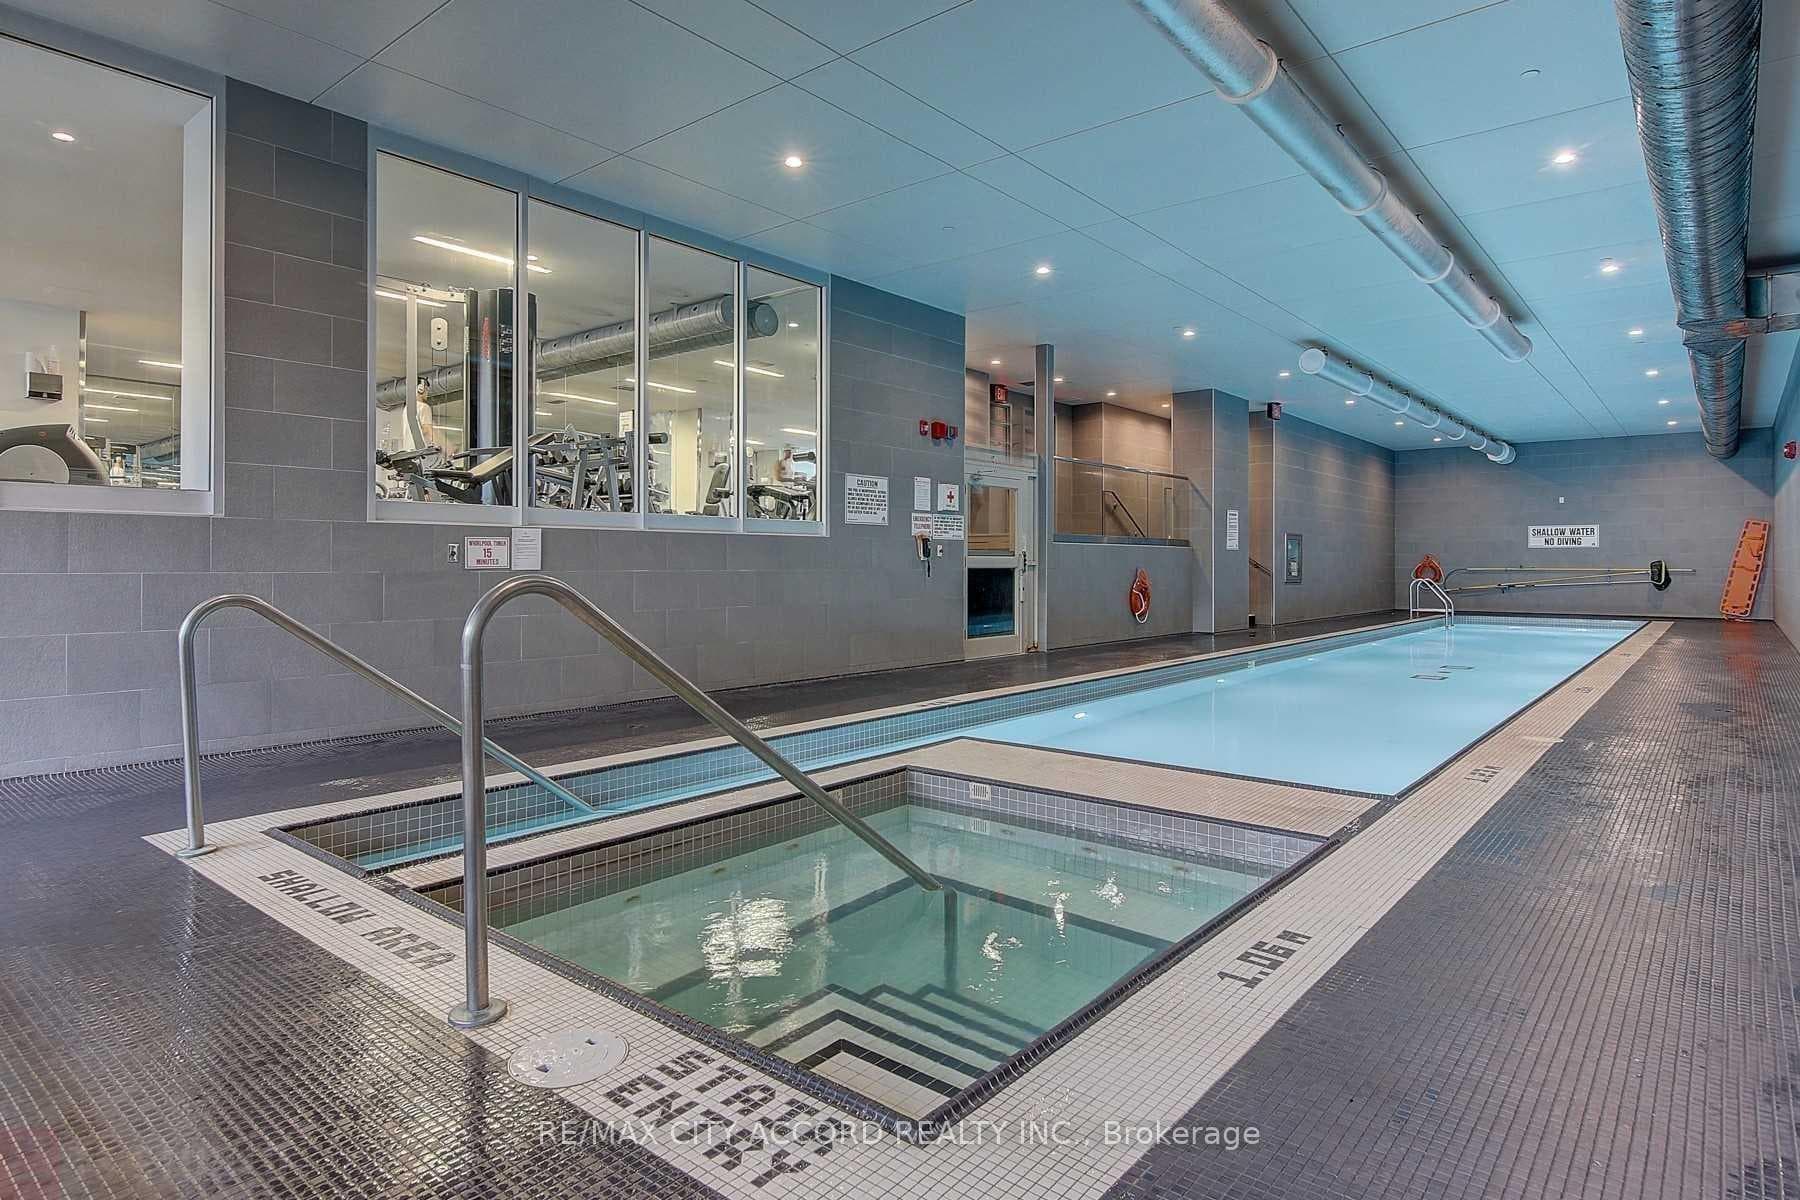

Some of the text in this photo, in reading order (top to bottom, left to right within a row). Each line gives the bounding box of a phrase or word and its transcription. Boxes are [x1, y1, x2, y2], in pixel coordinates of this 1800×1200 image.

[856, 479, 879, 488] CAUTION
[1531, 527, 1595, 537] SHALLOW WATER
[1544, 537, 1582, 546] NO DIVING
[482, 548, 492, 558] 15
[257, 869, 455, 970] SHALLOW AREA
